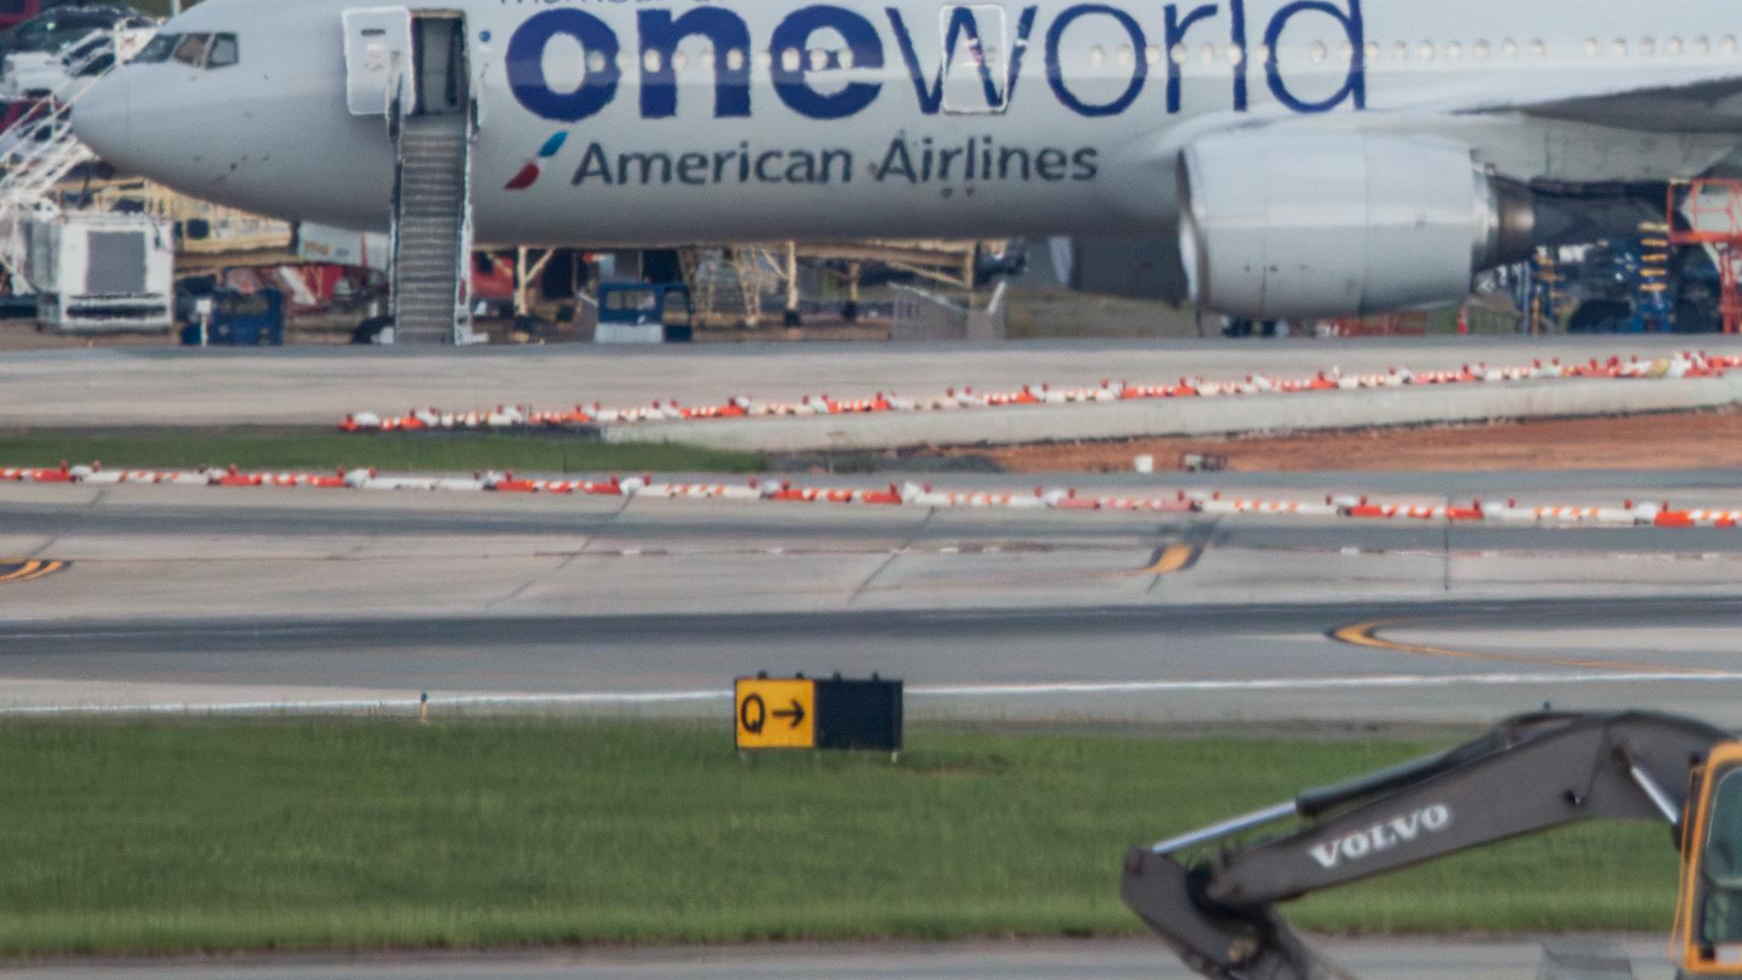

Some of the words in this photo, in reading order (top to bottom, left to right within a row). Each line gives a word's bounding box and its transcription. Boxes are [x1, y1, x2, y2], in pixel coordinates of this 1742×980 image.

[570, 141, 854, 186] American
[874, 135, 1098, 185] Airlines
[740, 693, 765, 734] Q
[1310, 804, 1449, 868] VOLVO
